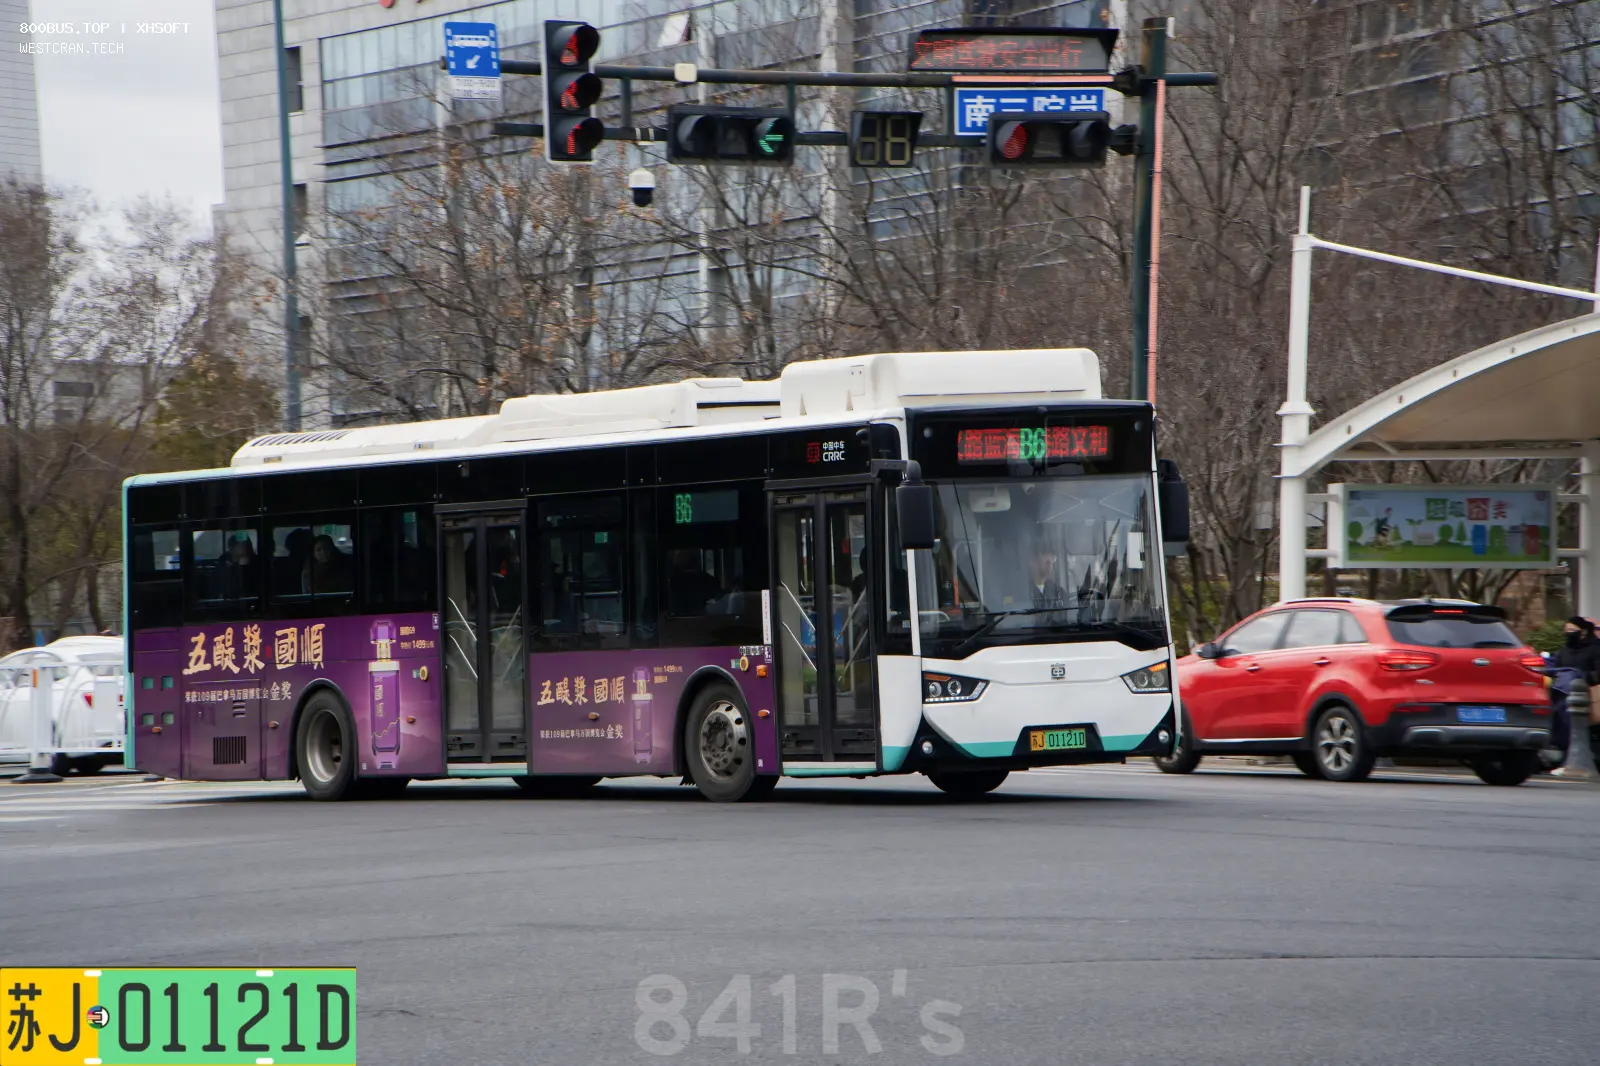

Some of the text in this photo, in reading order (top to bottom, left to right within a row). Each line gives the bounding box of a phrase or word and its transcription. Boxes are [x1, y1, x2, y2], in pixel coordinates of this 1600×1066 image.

[822, 450, 846, 462] CRRC
[1019, 427, 1046, 460] B6
[675, 492, 692, 524] B6
